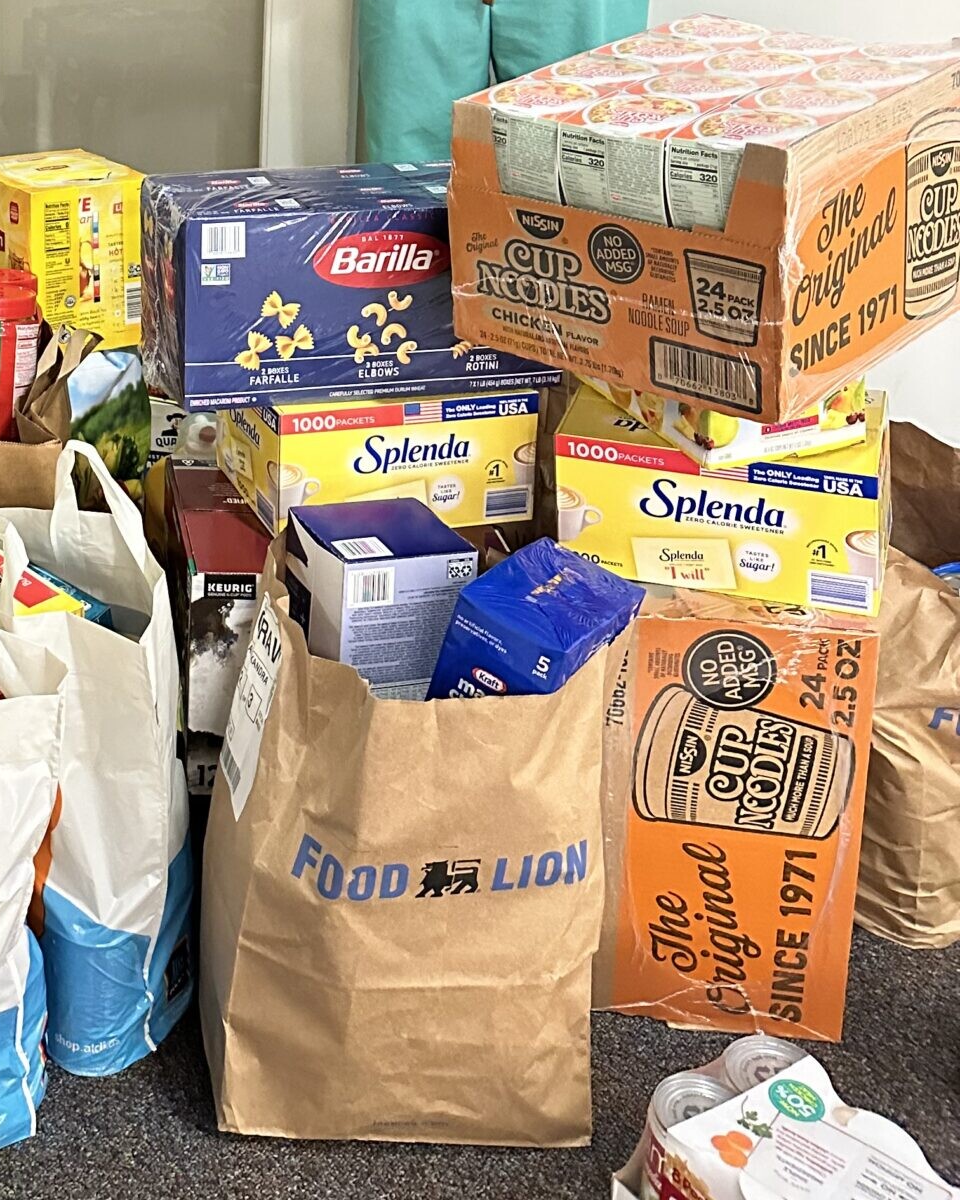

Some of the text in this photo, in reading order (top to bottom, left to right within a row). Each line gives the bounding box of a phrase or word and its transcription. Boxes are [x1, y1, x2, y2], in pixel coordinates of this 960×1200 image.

[562, 131, 605, 146] Nutrition Facts
[562, 154, 605, 167] Calories 320
[672, 147, 718, 160] Nutrition Facts
[931, 150, 953, 169] NISSIN
[670, 171, 718, 183] Calories 320
[922, 180, 959, 222] CUP
[522, 214, 560, 232] NISSIN
[816, 182, 866, 254] The
[466, 238, 498, 253] Original
[472, 232, 487, 242] The
[603, 235, 622, 248] NO
[330, 243, 433, 275] Barilla
[506, 241, 580, 281] CUP
[596, 248, 636, 260] ADDED
[792, 186, 897, 327] Original
[478, 262, 609, 323] NOODLES
[696, 277, 755, 308] 24 PACK
[642, 293, 675, 315] RAMEN
[698, 298, 724, 316] 2.5
[492, 307, 563, 336] CHICKEN
[566, 331, 599, 346] FLAVOR
[628, 308, 690, 337] NOODLE SOUP
[790, 283, 898, 376] SINCE 1971
[490, 332, 498, 341] 2.5
[372, 360, 394, 368] BOXES
[465, 361, 499, 371] ROTINI
[475, 353, 497, 361] BOXES
[249, 373, 300, 386] FARFALLE
[267, 366, 290, 375] BOXES
[358, 367, 400, 378] ELBOWS
[674, 376, 737, 401] 70662 13803
[499, 402, 528, 416] USA
[263, 409, 277, 432] USA
[292, 414, 375, 432] 1000 PACKETS
[353, 433, 470, 474] Splenda
[568, 441, 665, 467] 1000 PACKETS
[434, 459, 469, 467] SWEETENER
[489, 464, 500, 477] #1
[767, 469, 792, 479] ONLY
[792, 474, 820, 484] Leading
[788, 480, 820, 489] Sweetener
[432, 491, 460, 503] Sugar!
[823, 480, 864, 497] USA
[640, 478, 785, 528] Splenda
[685, 516, 785, 535] ZERO CALORIE SWEETENER
[659, 548, 704, 562] Splenda
[745, 550, 769, 558] TASTES
[812, 544, 827, 559] #1
[601, 559, 623, 568] PACKETS
[739, 559, 775, 574] Sugar!
[208, 583, 252, 593] KEURIG
[464, 619, 485, 634] artificial
[455, 620, 508, 655] preservatives, dyes
[536, 656, 551, 673] 5
[700, 658, 720, 687] NO
[717, 640, 742, 700] ADDED
[478, 671, 500, 690] Kraft
[532, 669, 548, 680] pack
[799, 638, 830, 710] 24 PACK
[833, 639, 861, 728] 2.5 OZ
[247, 692, 255, 709] 3
[803, 736, 816, 749] SOUP
[678, 734, 698, 774] NISSIN
[709, 725, 753, 800] CUP
[795, 754, 811, 775] THAN
[739, 720, 797, 829] NOODLES
[789, 775, 806, 798] MORE
[784, 798, 800, 821] MUCH
[290, 833, 589, 901] FOOD LION
[649, 891, 698, 973] The
[682, 841, 762, 1016] Original
[768, 849, 817, 1023] SINCE 1971
[776, 1085, 816, 1117] 50%
